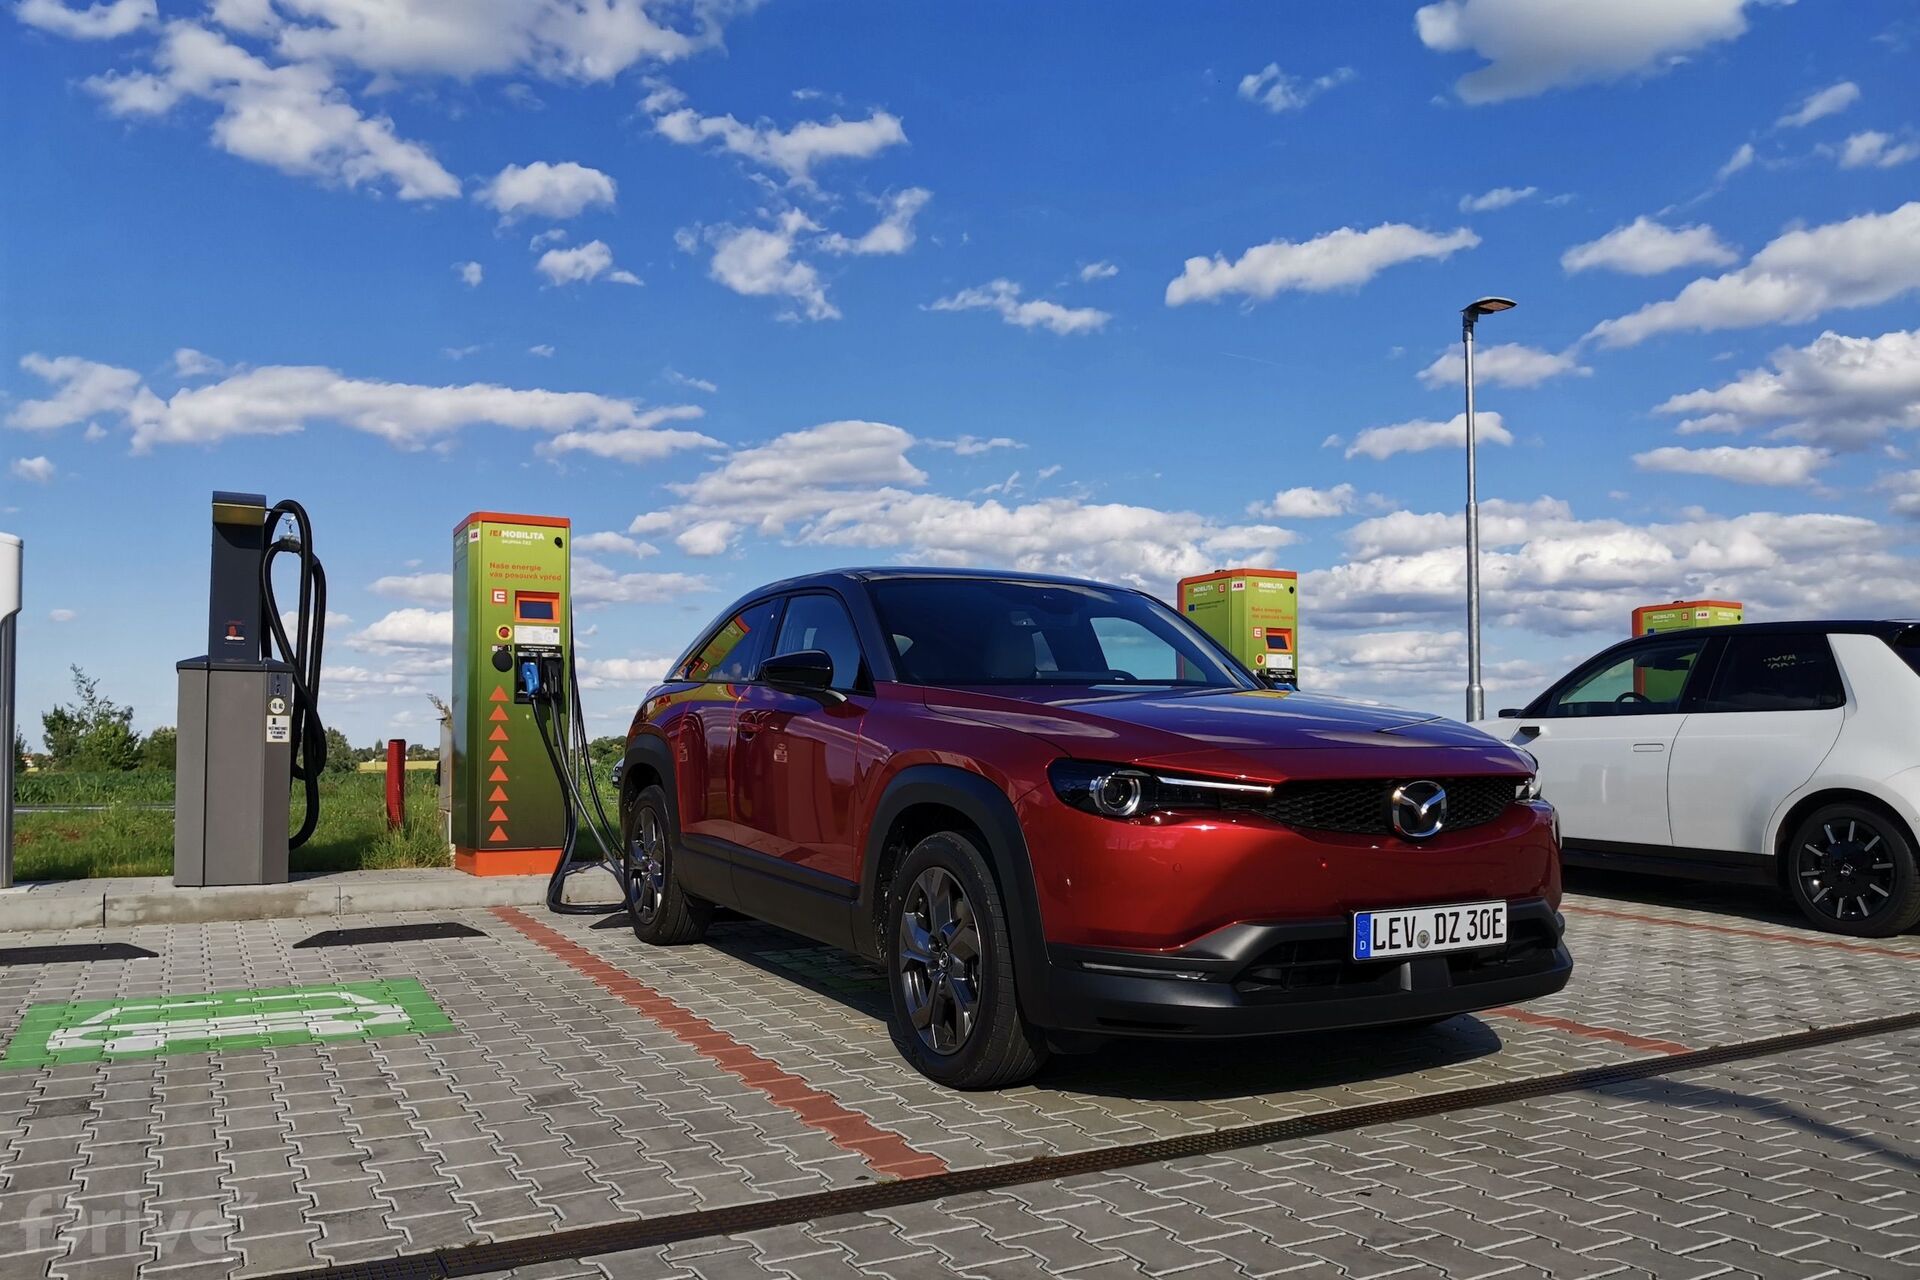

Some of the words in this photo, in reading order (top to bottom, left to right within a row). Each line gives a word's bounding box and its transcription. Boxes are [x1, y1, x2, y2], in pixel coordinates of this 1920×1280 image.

[1359, 940, 1367, 950] D
[1373, 916, 1417, 950] LEV
[1434, 911, 1460, 945] DZ
[1467, 908, 1503, 941] 30E
